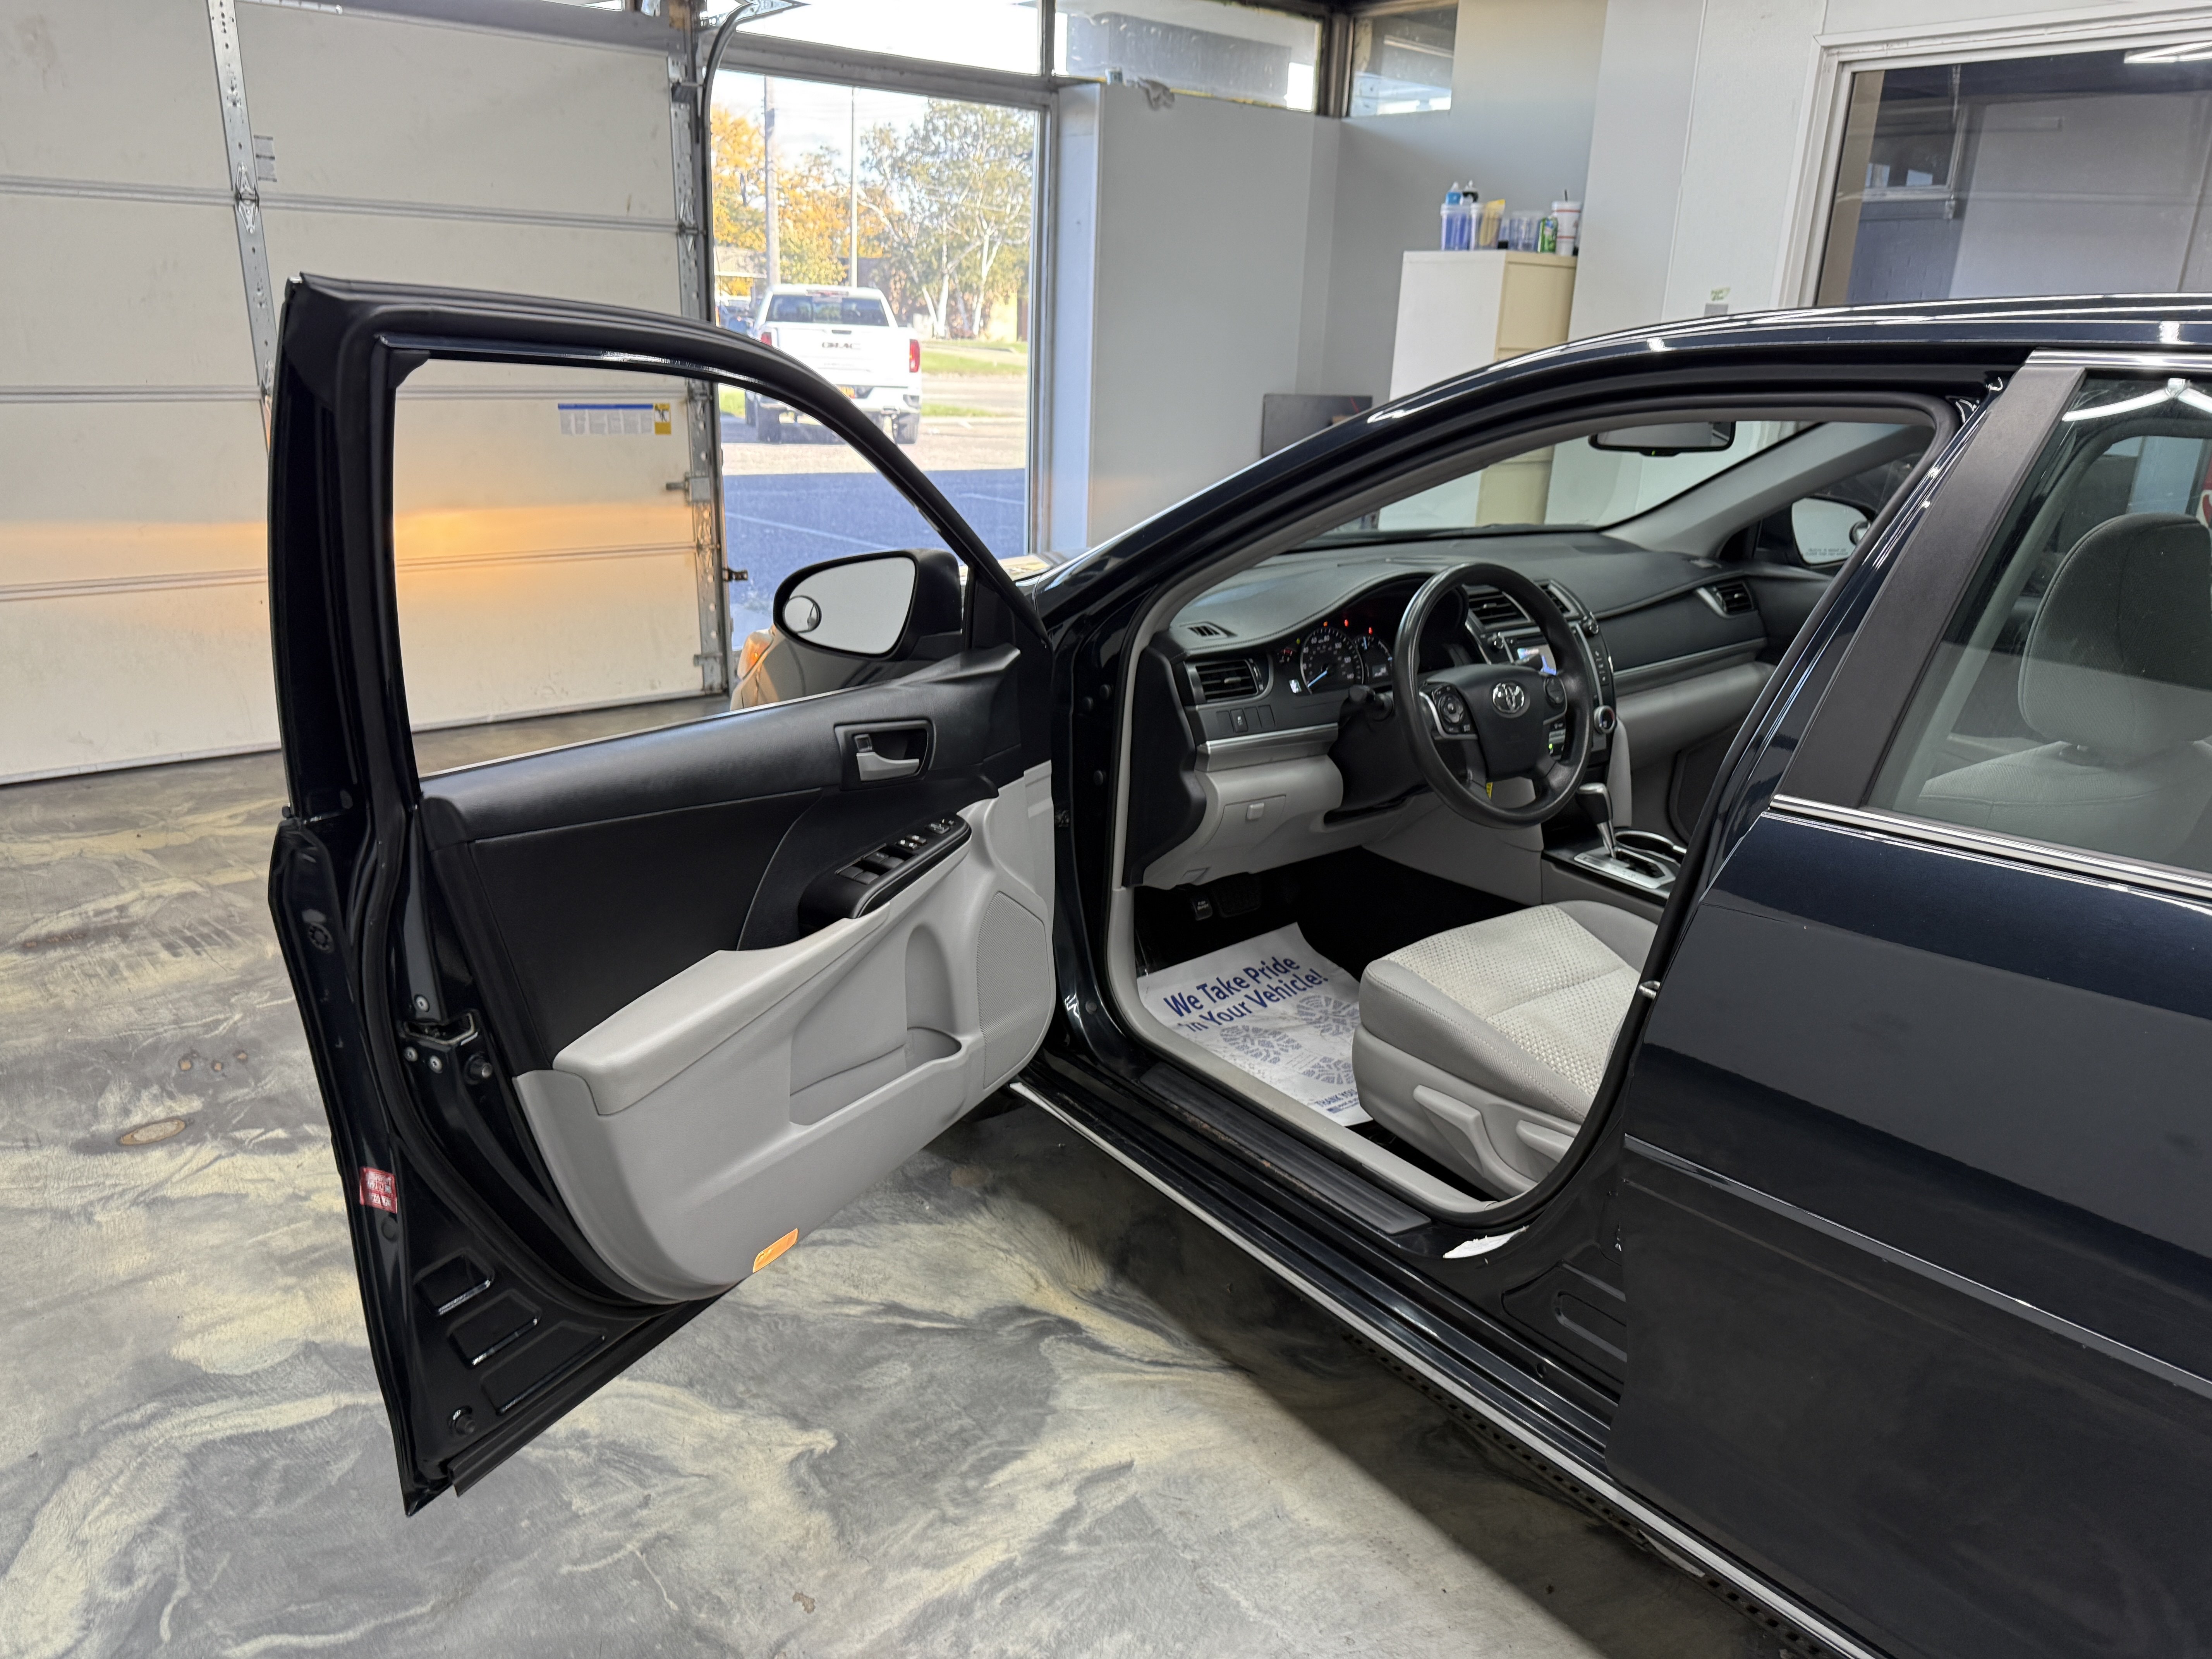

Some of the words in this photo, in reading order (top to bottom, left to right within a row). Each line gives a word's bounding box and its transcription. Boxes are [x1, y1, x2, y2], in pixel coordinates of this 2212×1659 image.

[821, 342, 861, 350] GMC
[1163, 992, 1204, 1017] We
[1196, 977, 1250, 1003] Take
[1243, 957, 1300, 984] Pride
[1199, 1001, 1252, 1025] Your
[1244, 968, 1328, 1008] Vehicle!
[1314, 1094, 1343, 1108] THANK
